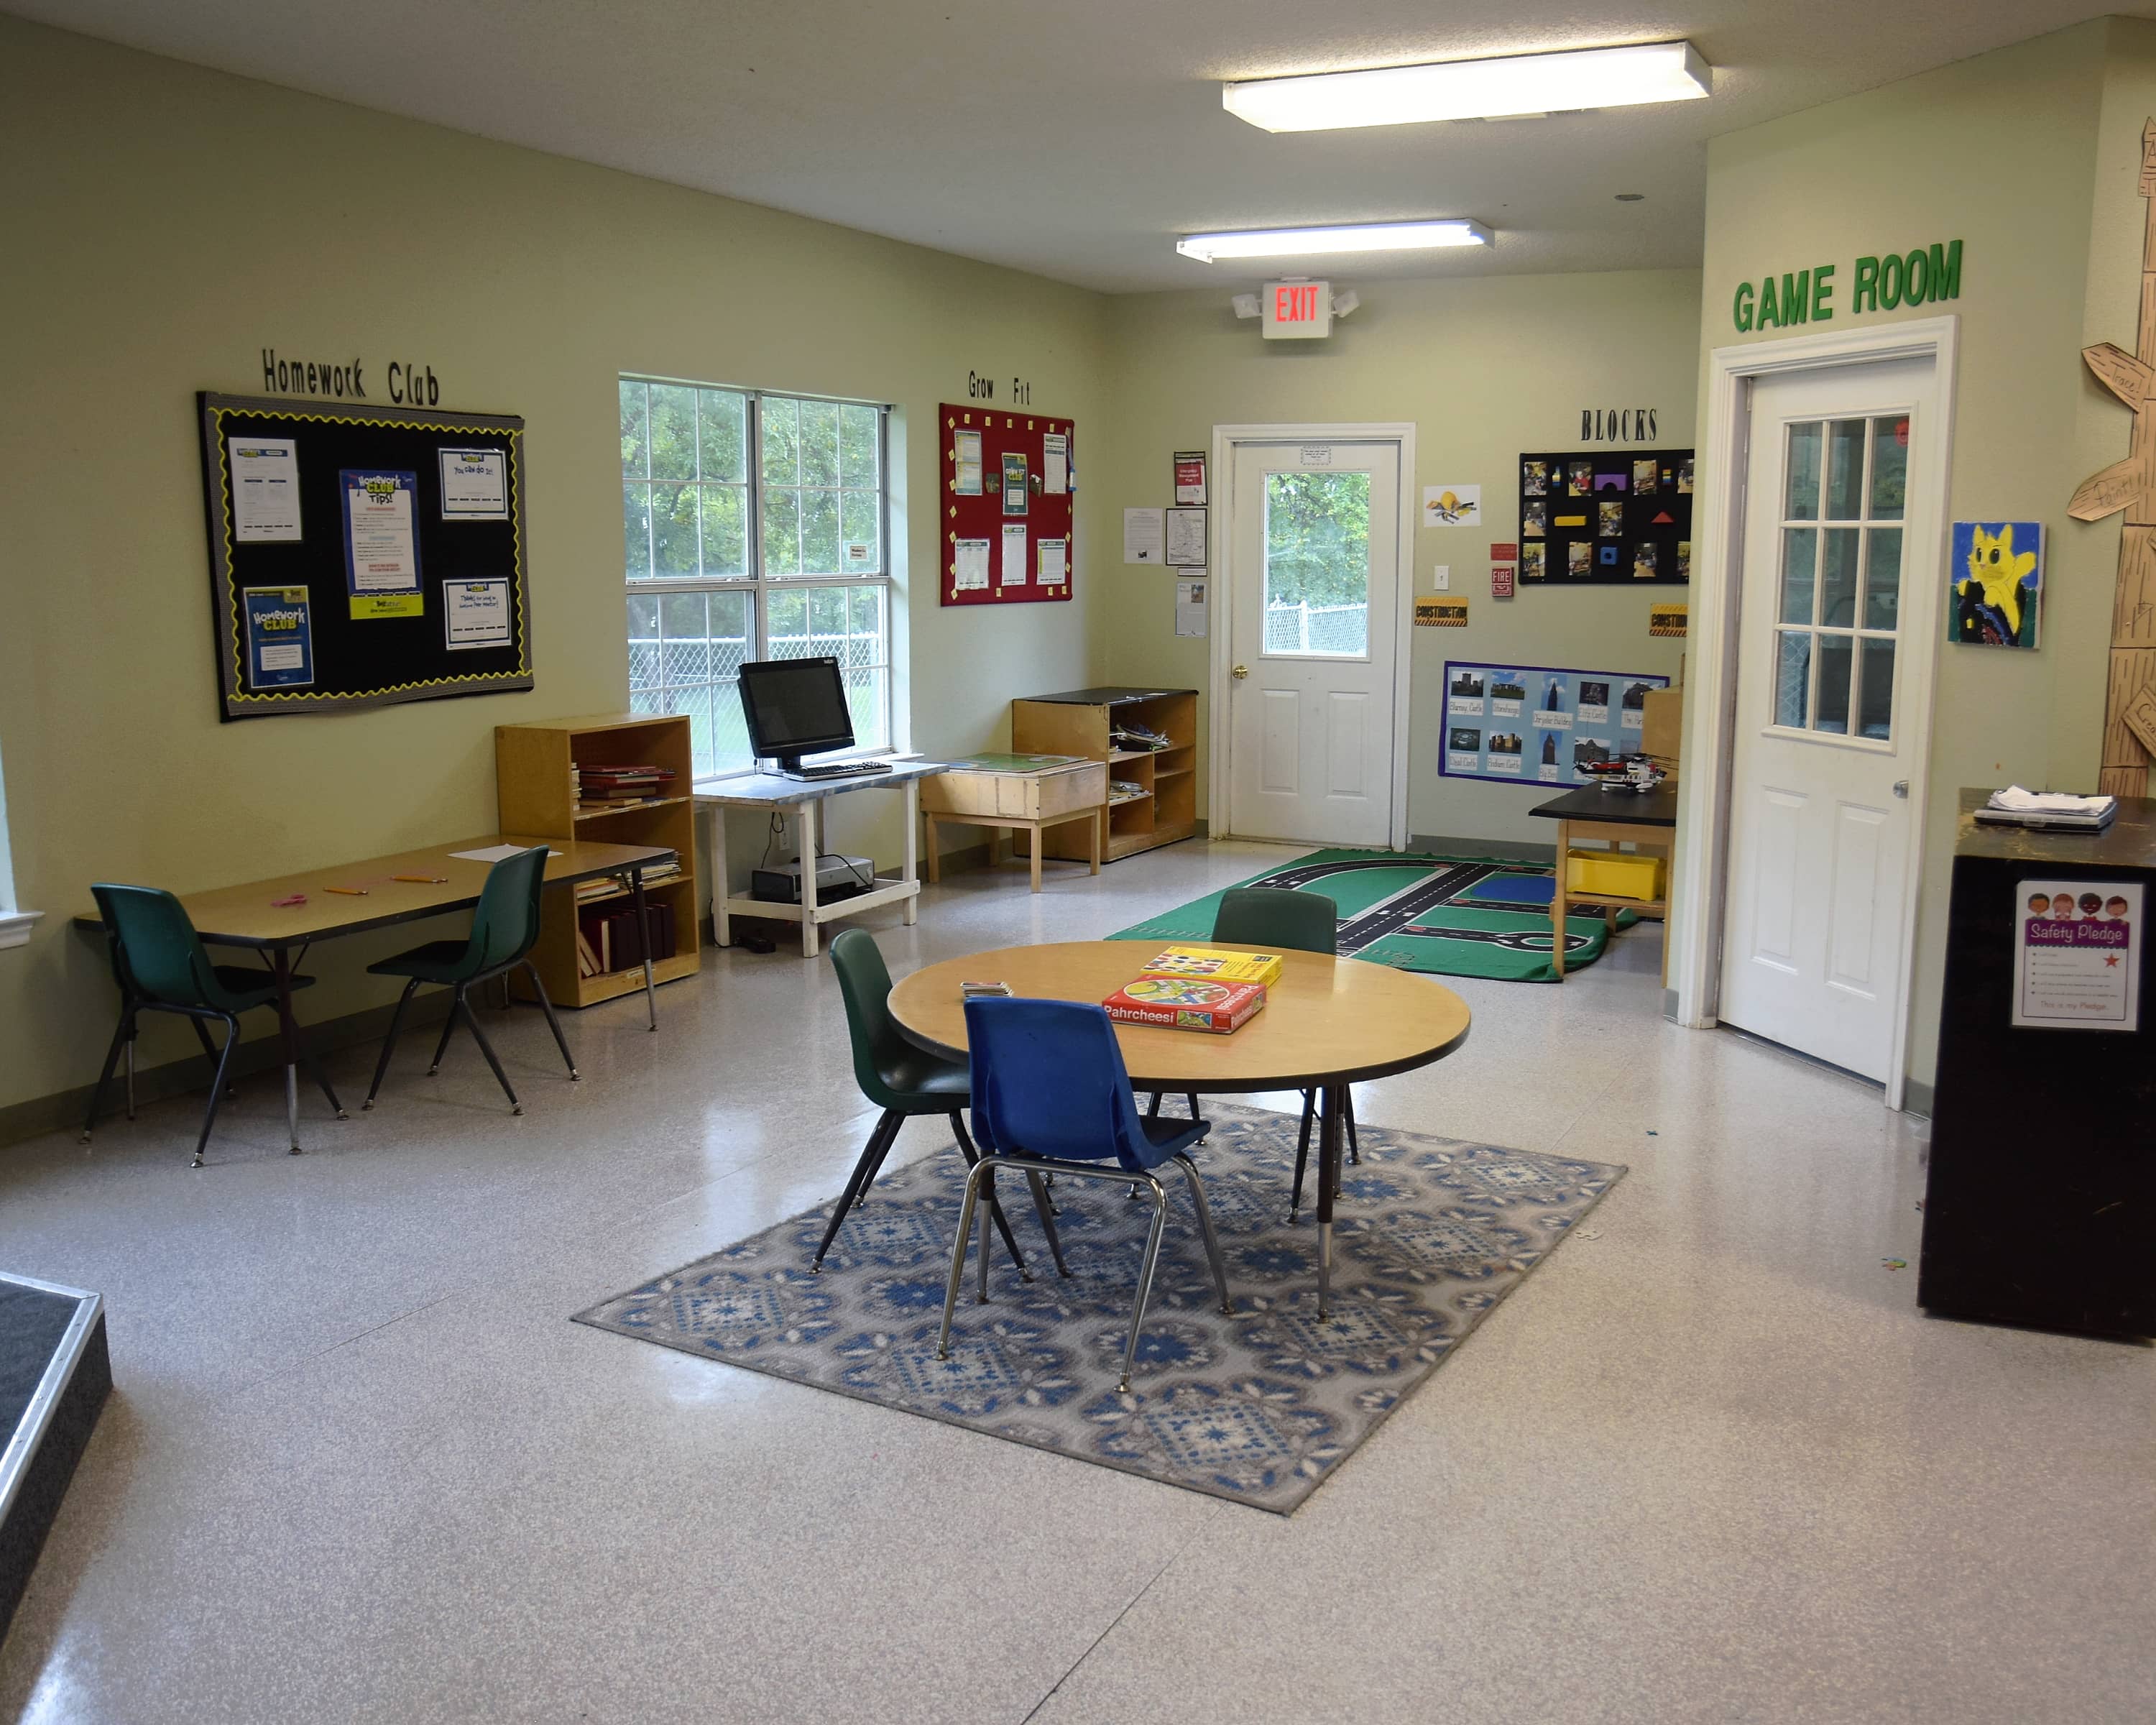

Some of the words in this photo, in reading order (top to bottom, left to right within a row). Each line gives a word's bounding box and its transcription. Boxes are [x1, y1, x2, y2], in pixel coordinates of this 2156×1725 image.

[1733, 264, 1835, 333] GAME
[1852, 239, 1964, 314] ROOM
[1276, 285, 1319, 322] EXIT
[262, 349, 367, 397] Homework
[387, 361, 439, 406] Club
[968, 369, 994, 399] Grow
[1013, 377, 1030, 406] Fit
[1580, 408, 1657, 442] BLOCKS
[366, 483, 395, 494] CLUB
[1493, 571, 1510, 582] FIRE
[254, 607, 305, 625] Homework
[1416, 605, 1468, 619] CONSTRUCTION
[263, 619, 298, 631] CLUB
[2030, 923, 2073, 943] Safety
[2078, 924, 2122, 944] Pledge
[1104, 1005, 1174, 1023] Pahrcheesi
